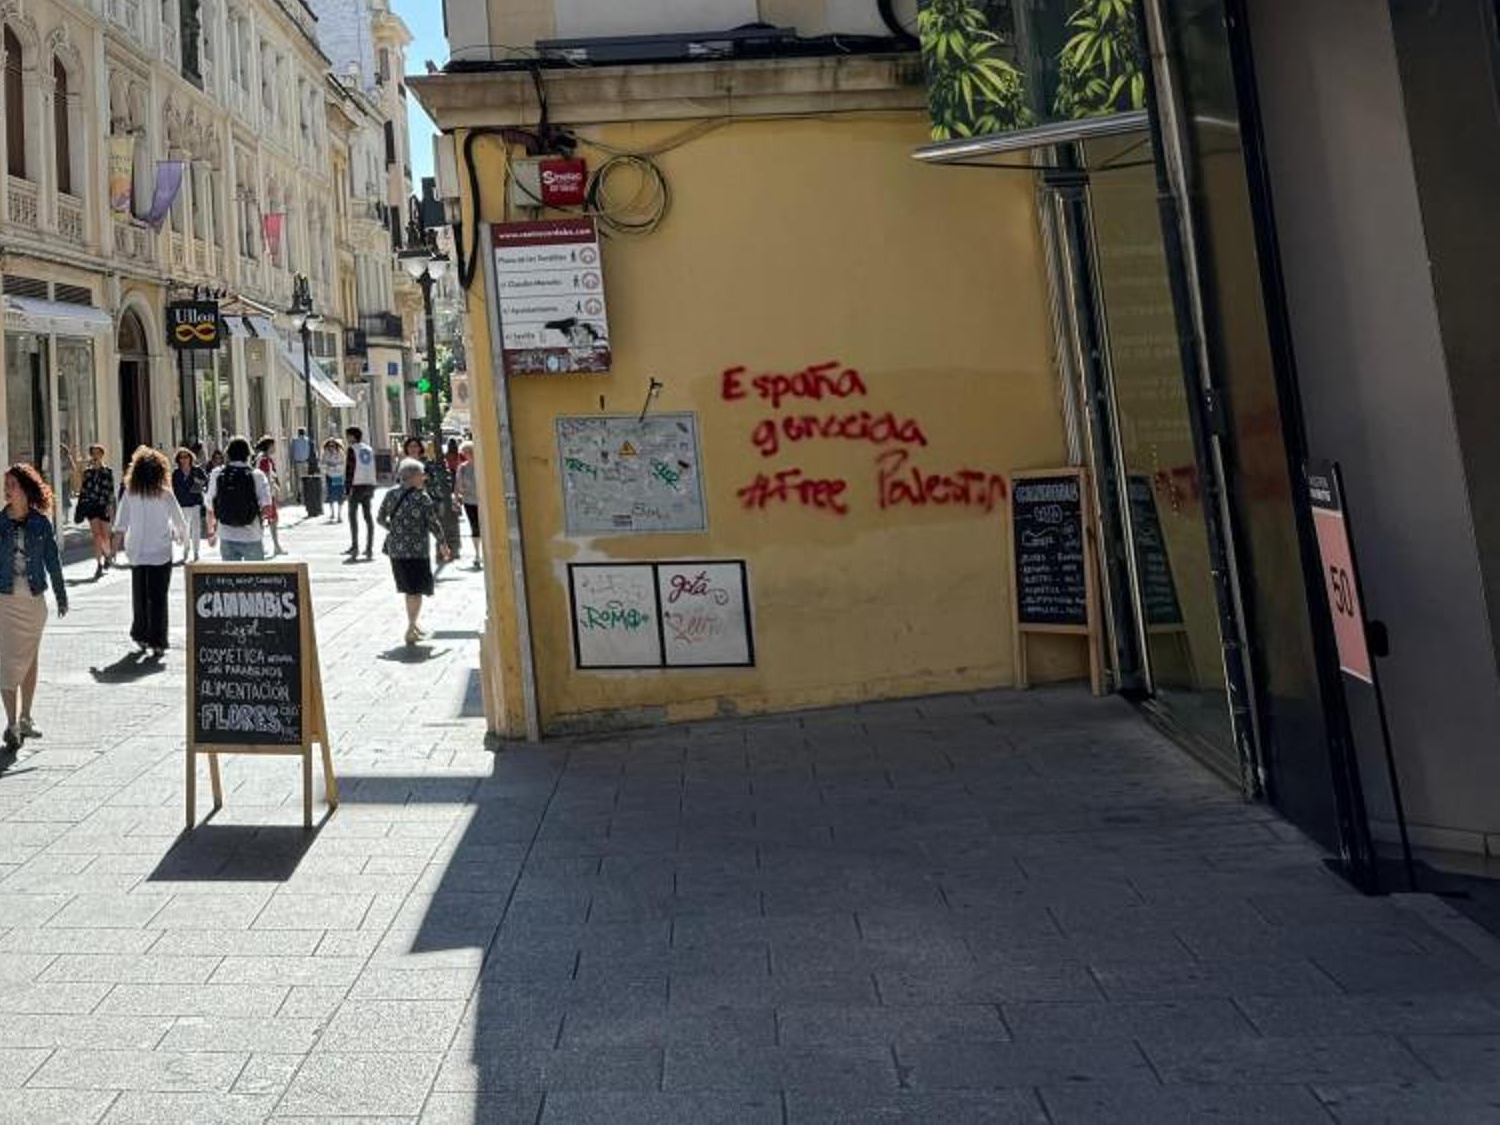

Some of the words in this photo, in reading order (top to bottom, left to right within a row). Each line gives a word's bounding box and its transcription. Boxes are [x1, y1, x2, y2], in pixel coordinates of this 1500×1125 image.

[175, 307, 216, 325] Ulloa
[721, 361, 867, 409] España
[737, 469, 849, 516] #Free
